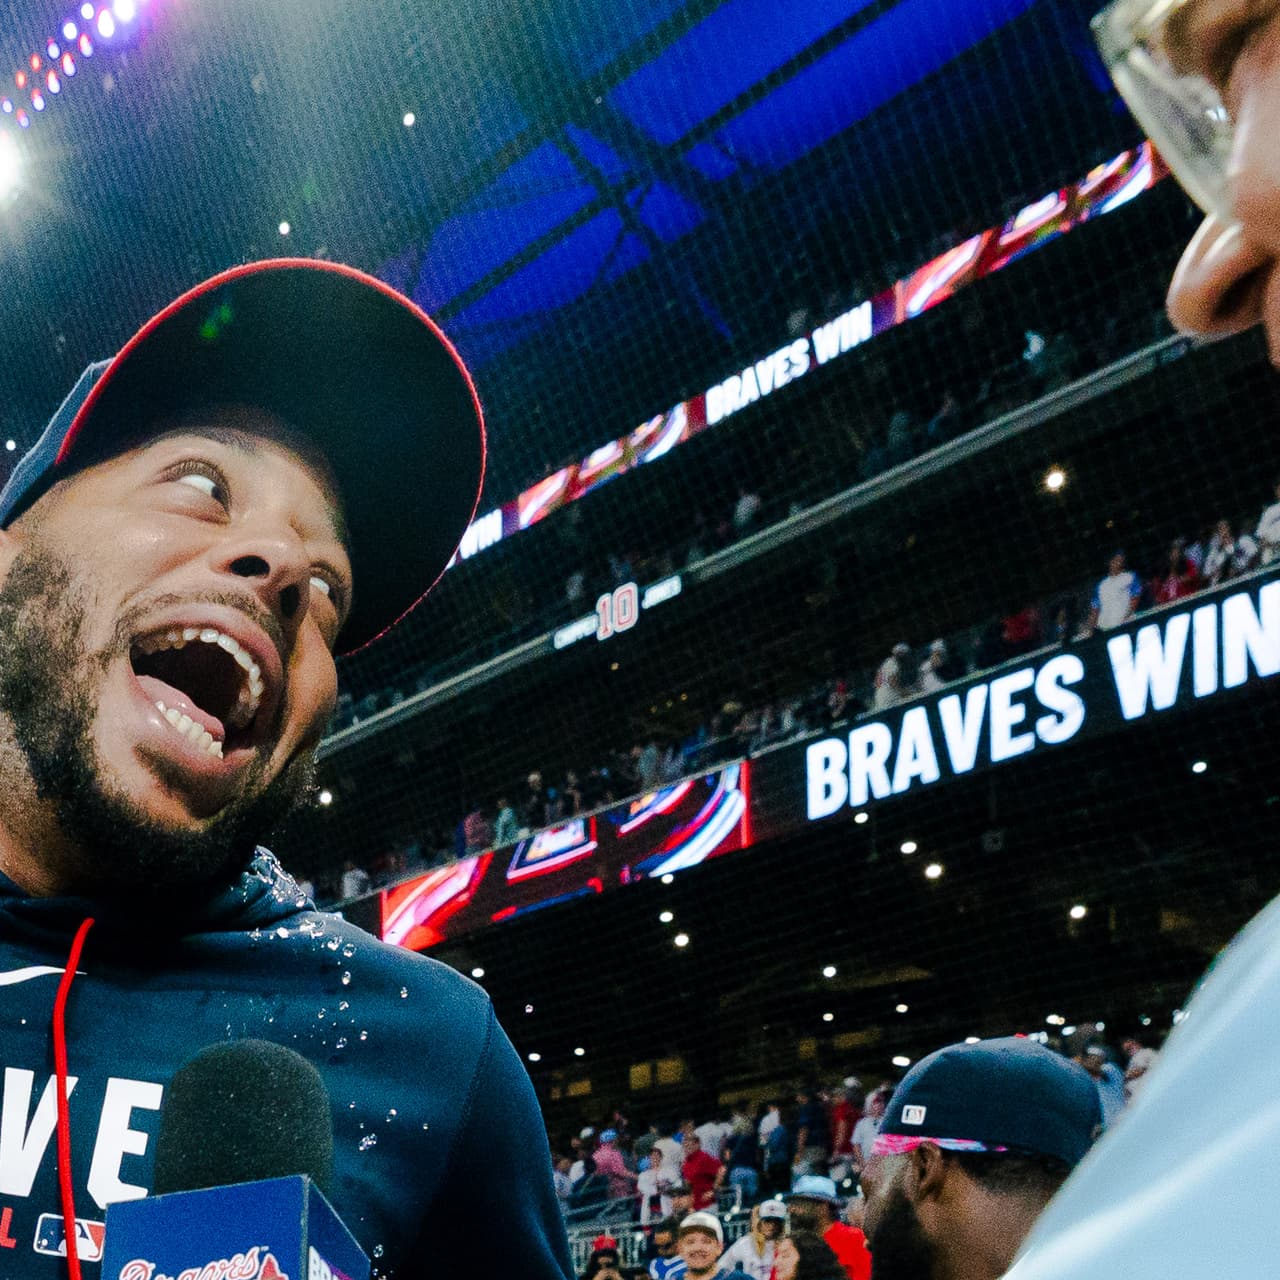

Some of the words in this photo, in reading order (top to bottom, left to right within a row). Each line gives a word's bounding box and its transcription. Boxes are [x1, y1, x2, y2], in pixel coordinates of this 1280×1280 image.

[706, 338, 811, 425] BRAVES
[811, 301, 873, 364] WIN
[595, 581, 639, 641] 10
[806, 654, 1086, 821] BRAVES
